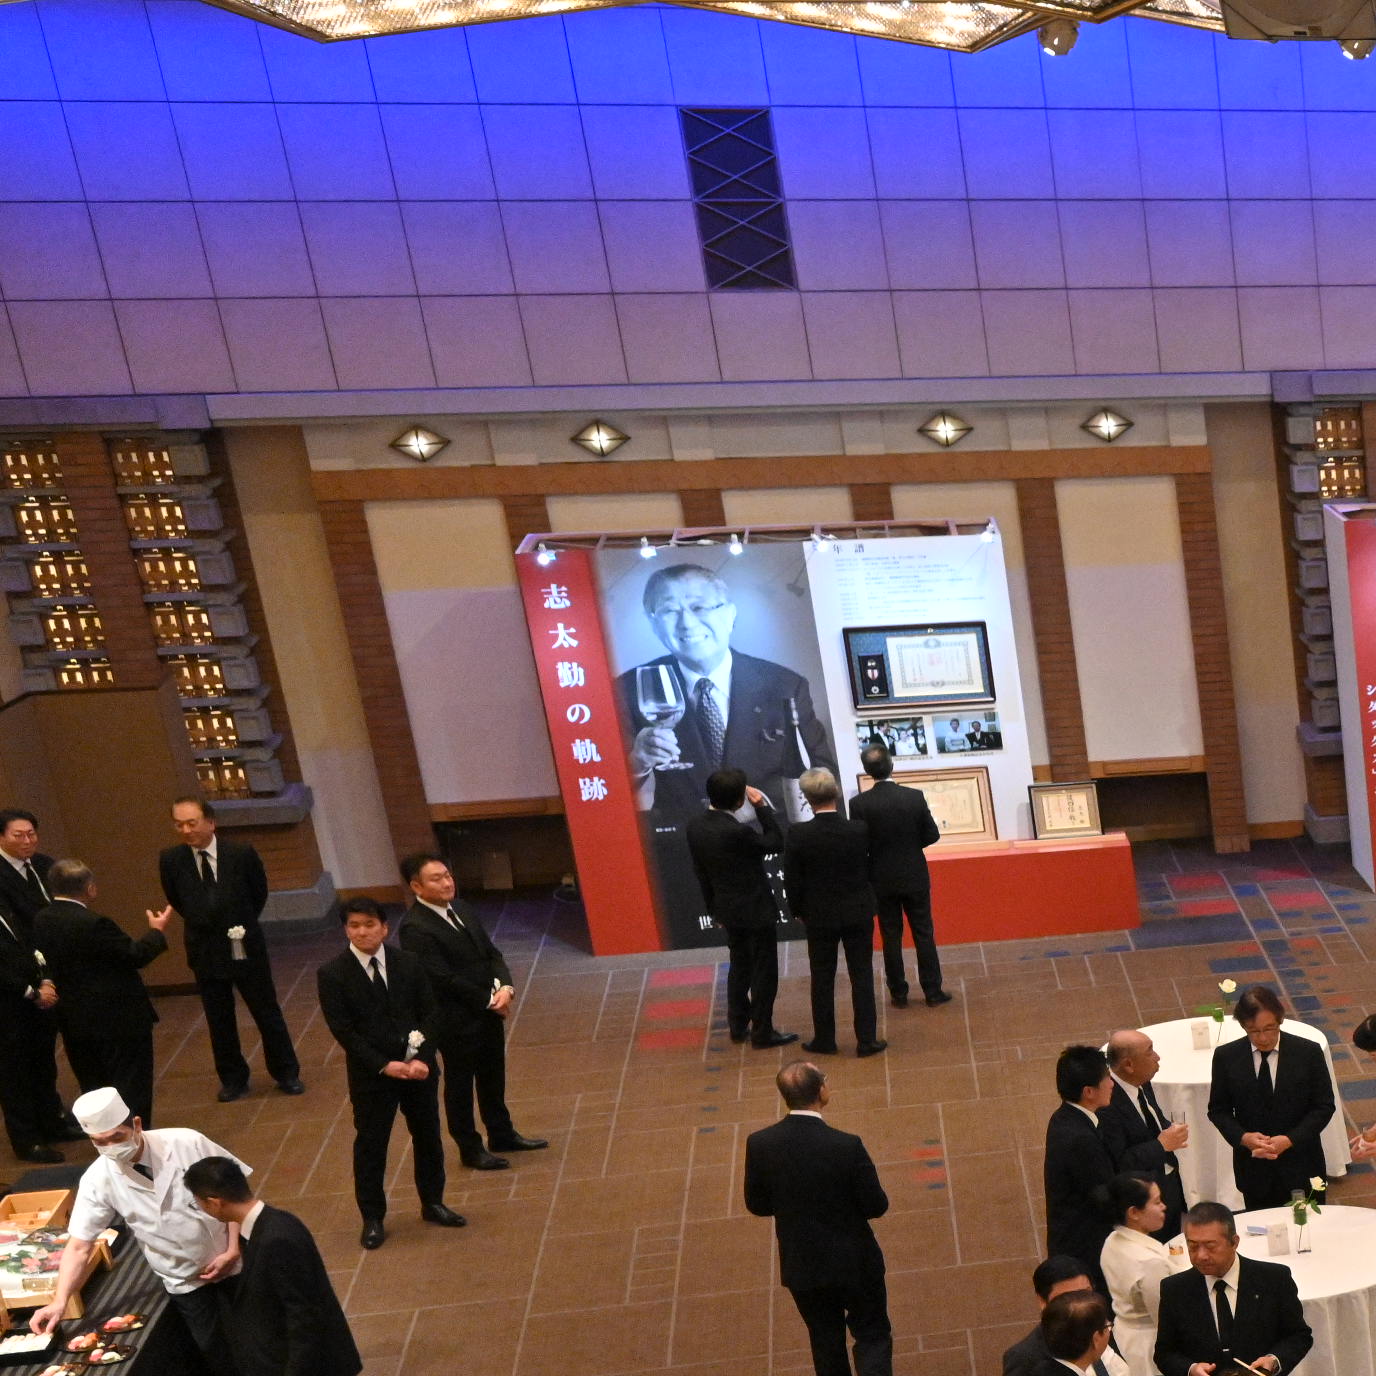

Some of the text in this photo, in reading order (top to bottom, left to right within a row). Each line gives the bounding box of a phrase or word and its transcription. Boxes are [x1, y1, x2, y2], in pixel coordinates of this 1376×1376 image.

[540, 583, 609, 802] 志太勤の軌跡
